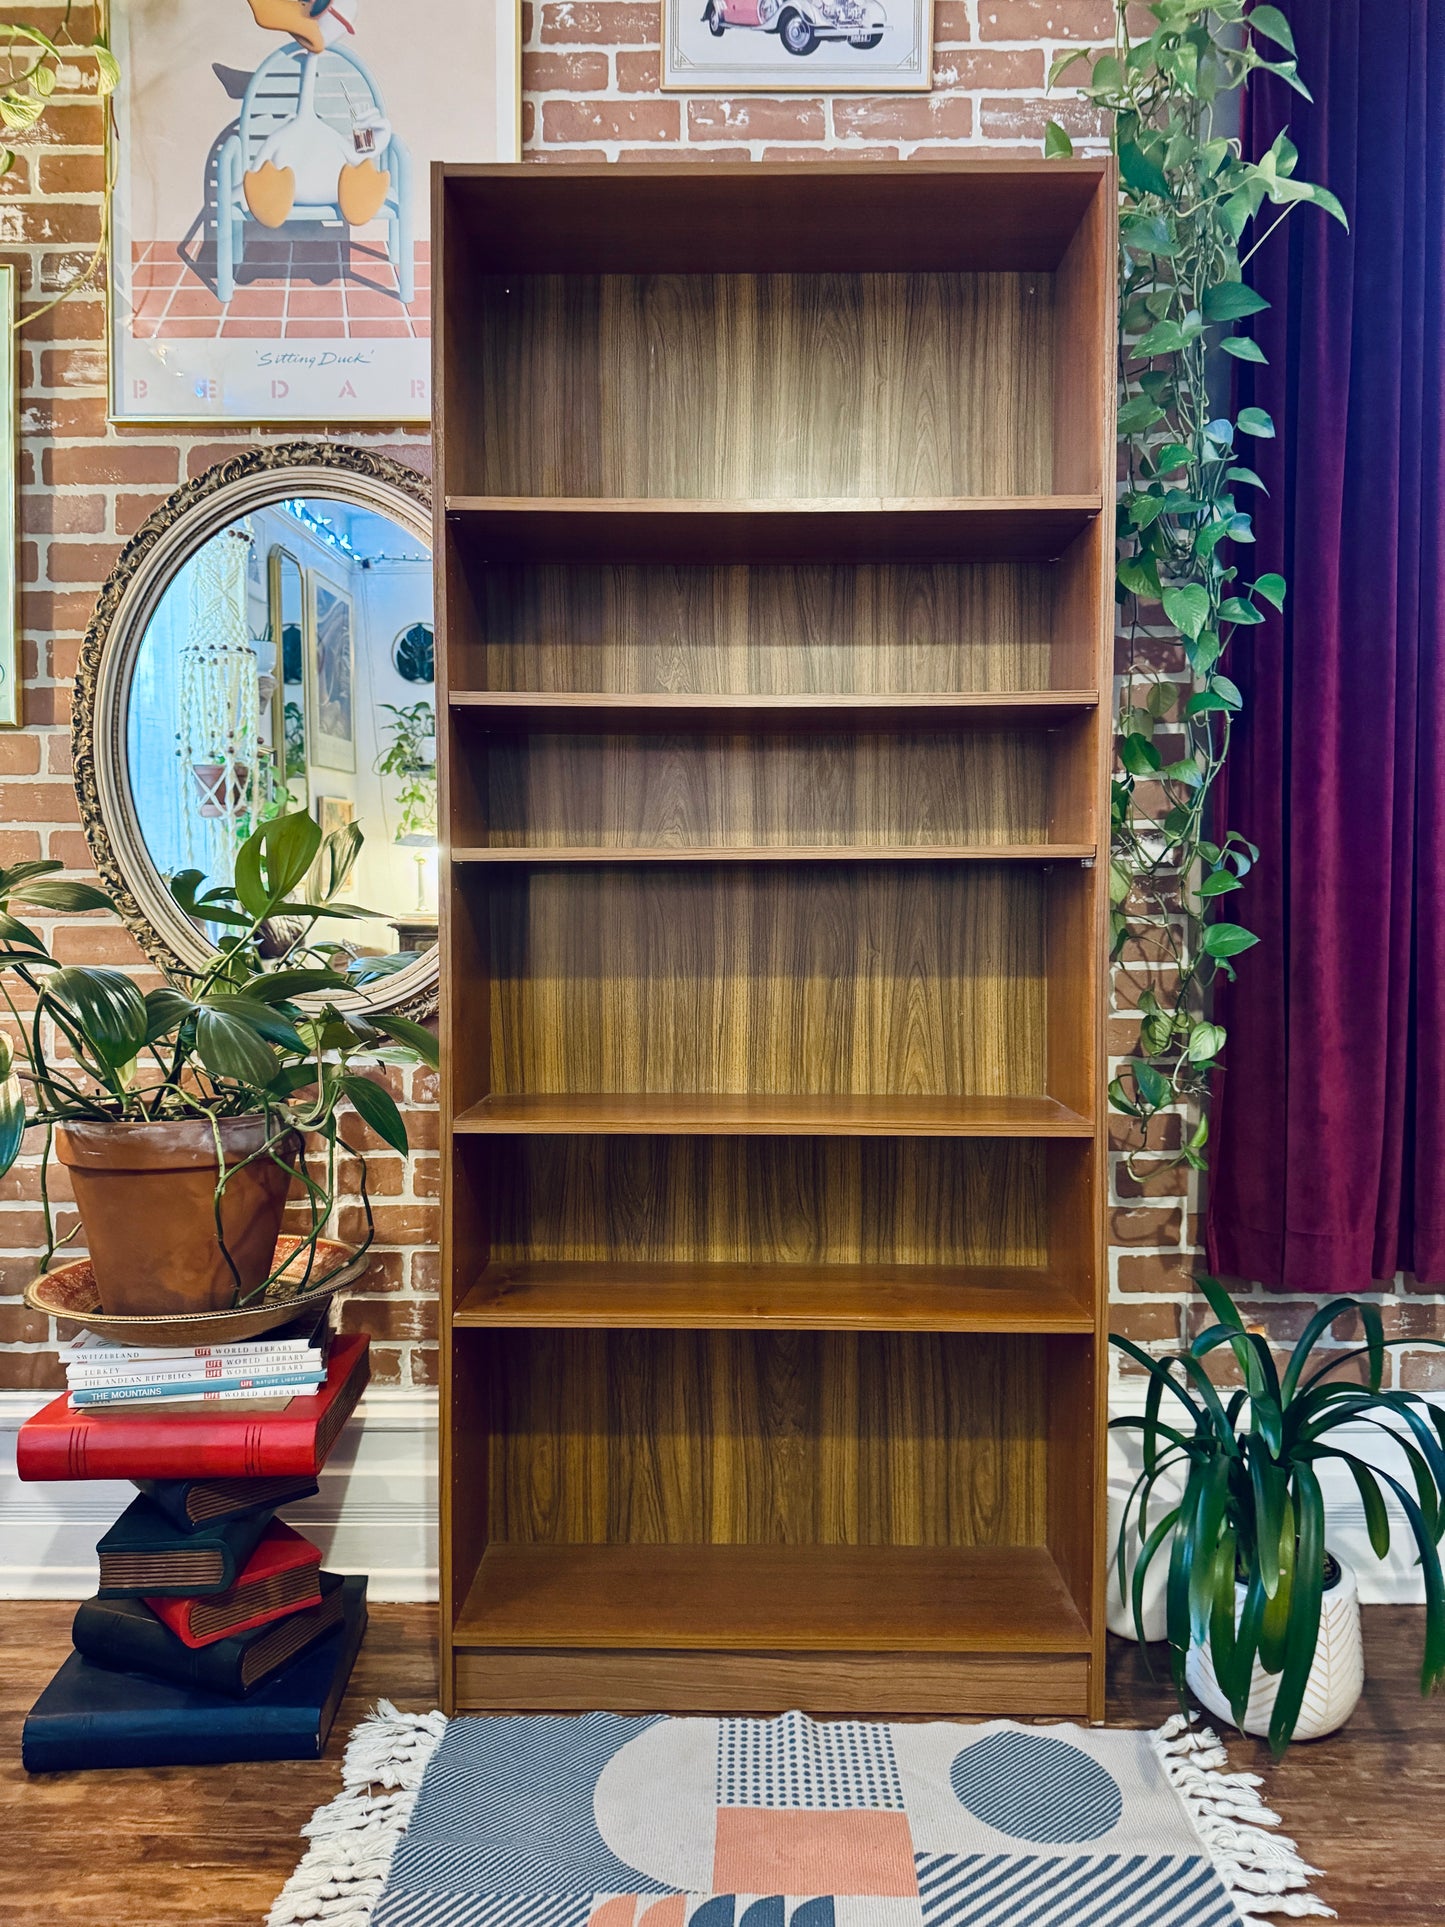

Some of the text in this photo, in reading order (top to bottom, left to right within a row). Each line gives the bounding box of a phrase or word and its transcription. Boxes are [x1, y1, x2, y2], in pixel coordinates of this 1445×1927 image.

[76, 1344, 293, 1361] SWITZERLAND LIFE WORLD LIBRARY
[84, 1354, 305, 1377] TURKEY LIFE WORLD LIBRARY
[84, 1364, 305, 1388] THE ANDEAN REPUBLICS LIFE WORLD LIBRARY
[91, 1392, 109, 1401] THE
[111, 1387, 162, 1399] MOUNTAINS
[204, 1392, 220, 1400] LIFE
